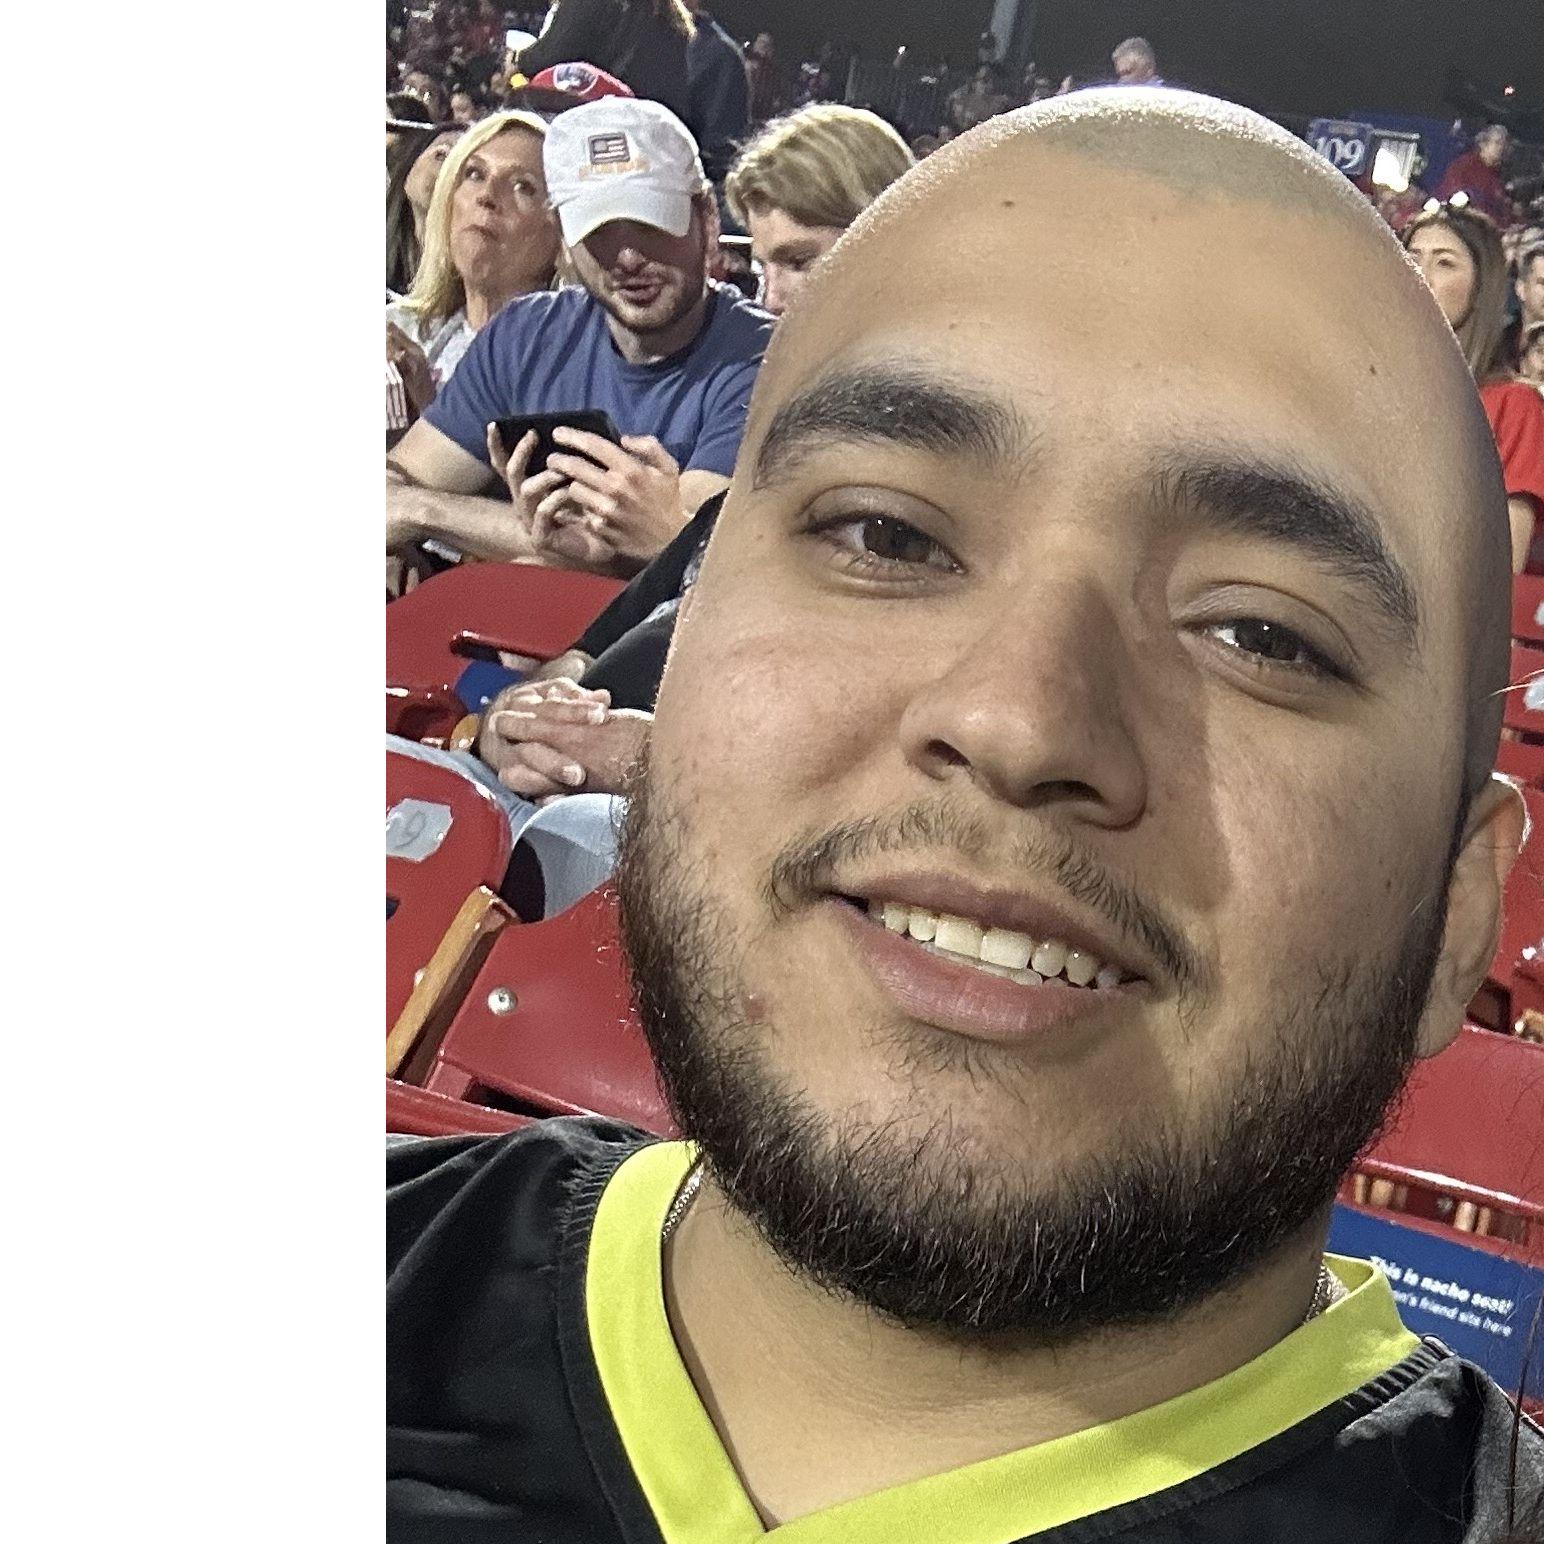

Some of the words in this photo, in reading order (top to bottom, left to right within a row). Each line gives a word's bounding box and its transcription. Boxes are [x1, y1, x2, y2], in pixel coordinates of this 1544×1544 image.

[1403, 1267, 1419, 1286] is
[1420, 1276, 1470, 1302] nacho
[1483, 1316, 1513, 1337] here
